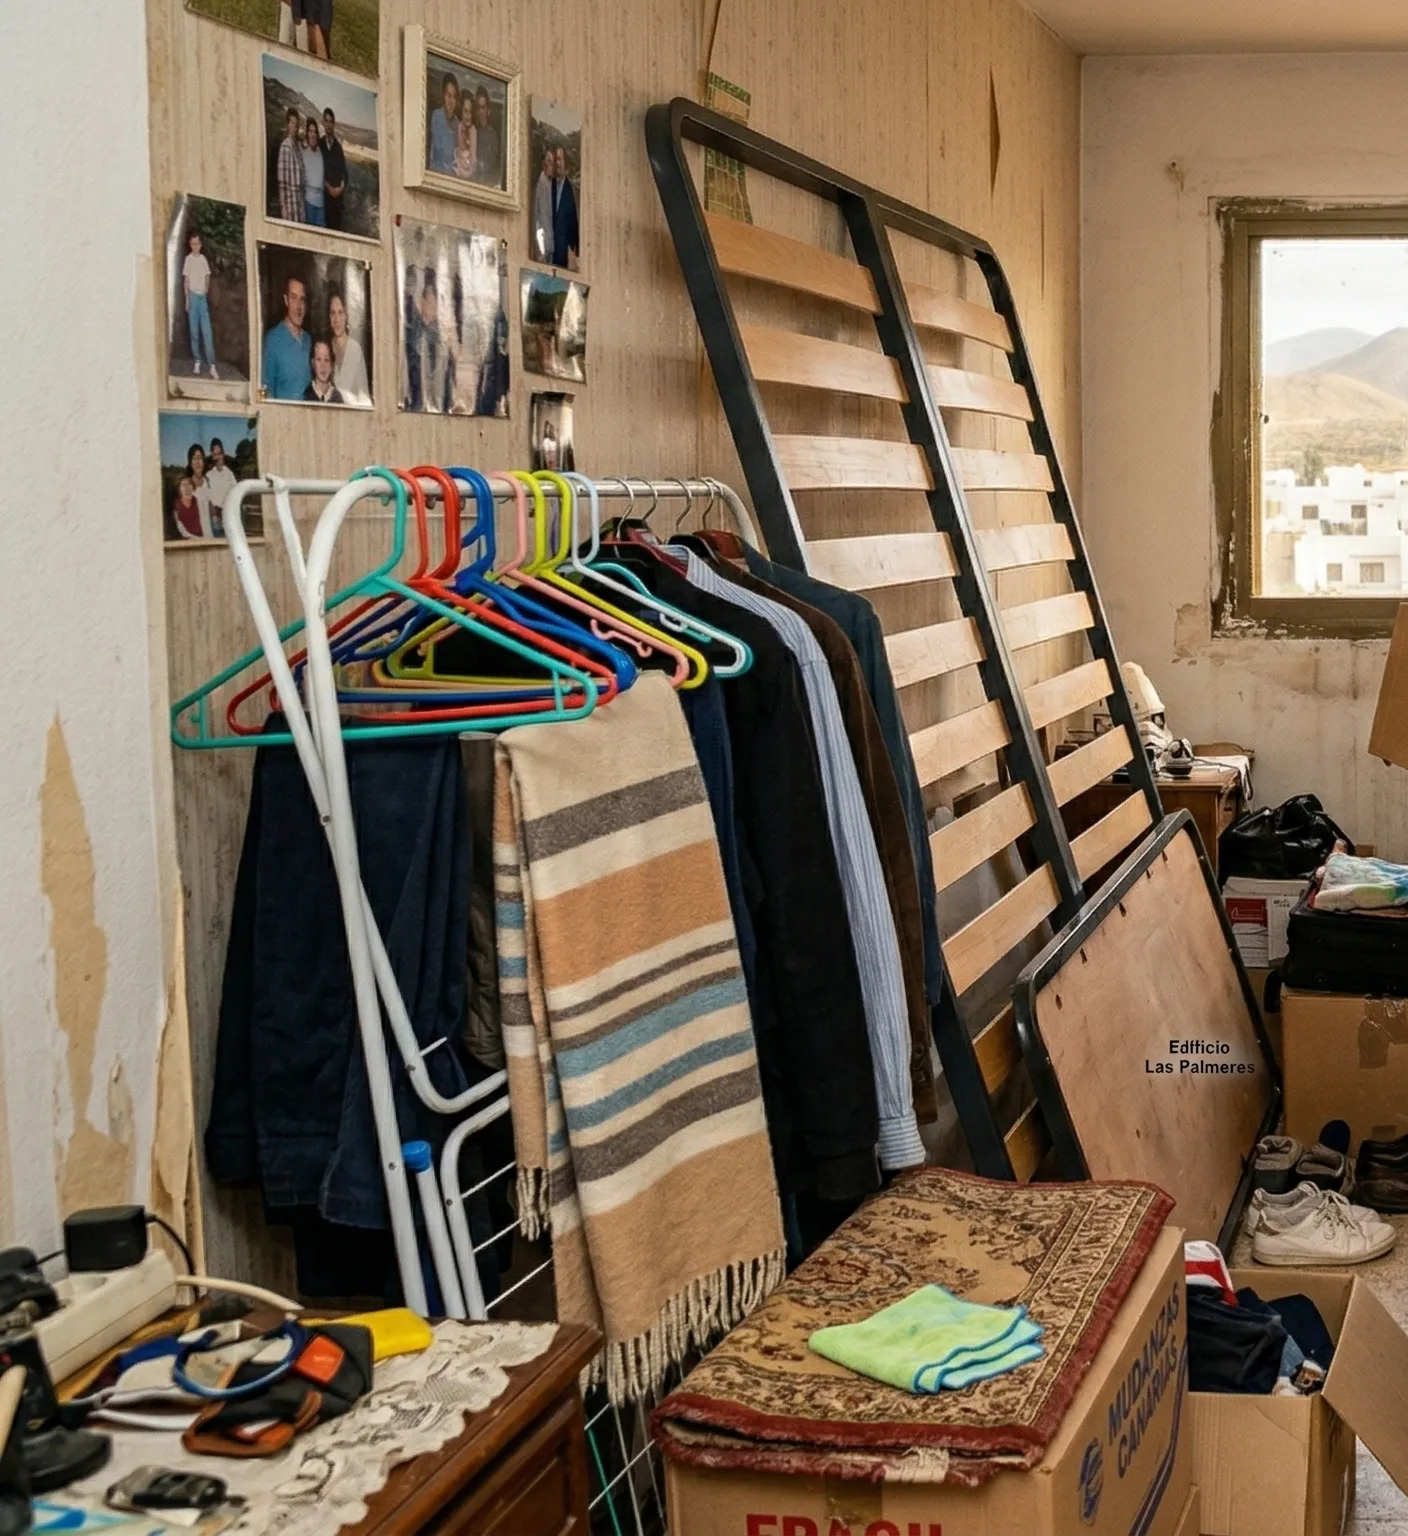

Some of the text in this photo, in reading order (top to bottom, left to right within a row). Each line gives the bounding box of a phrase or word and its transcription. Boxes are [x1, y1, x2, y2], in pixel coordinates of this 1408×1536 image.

[1145, 1059, 1256, 1074] Las Palmeres
[1108, 1280, 1180, 1446] MUDANZAS
[1118, 1334, 1178, 1479] CANARIAS
